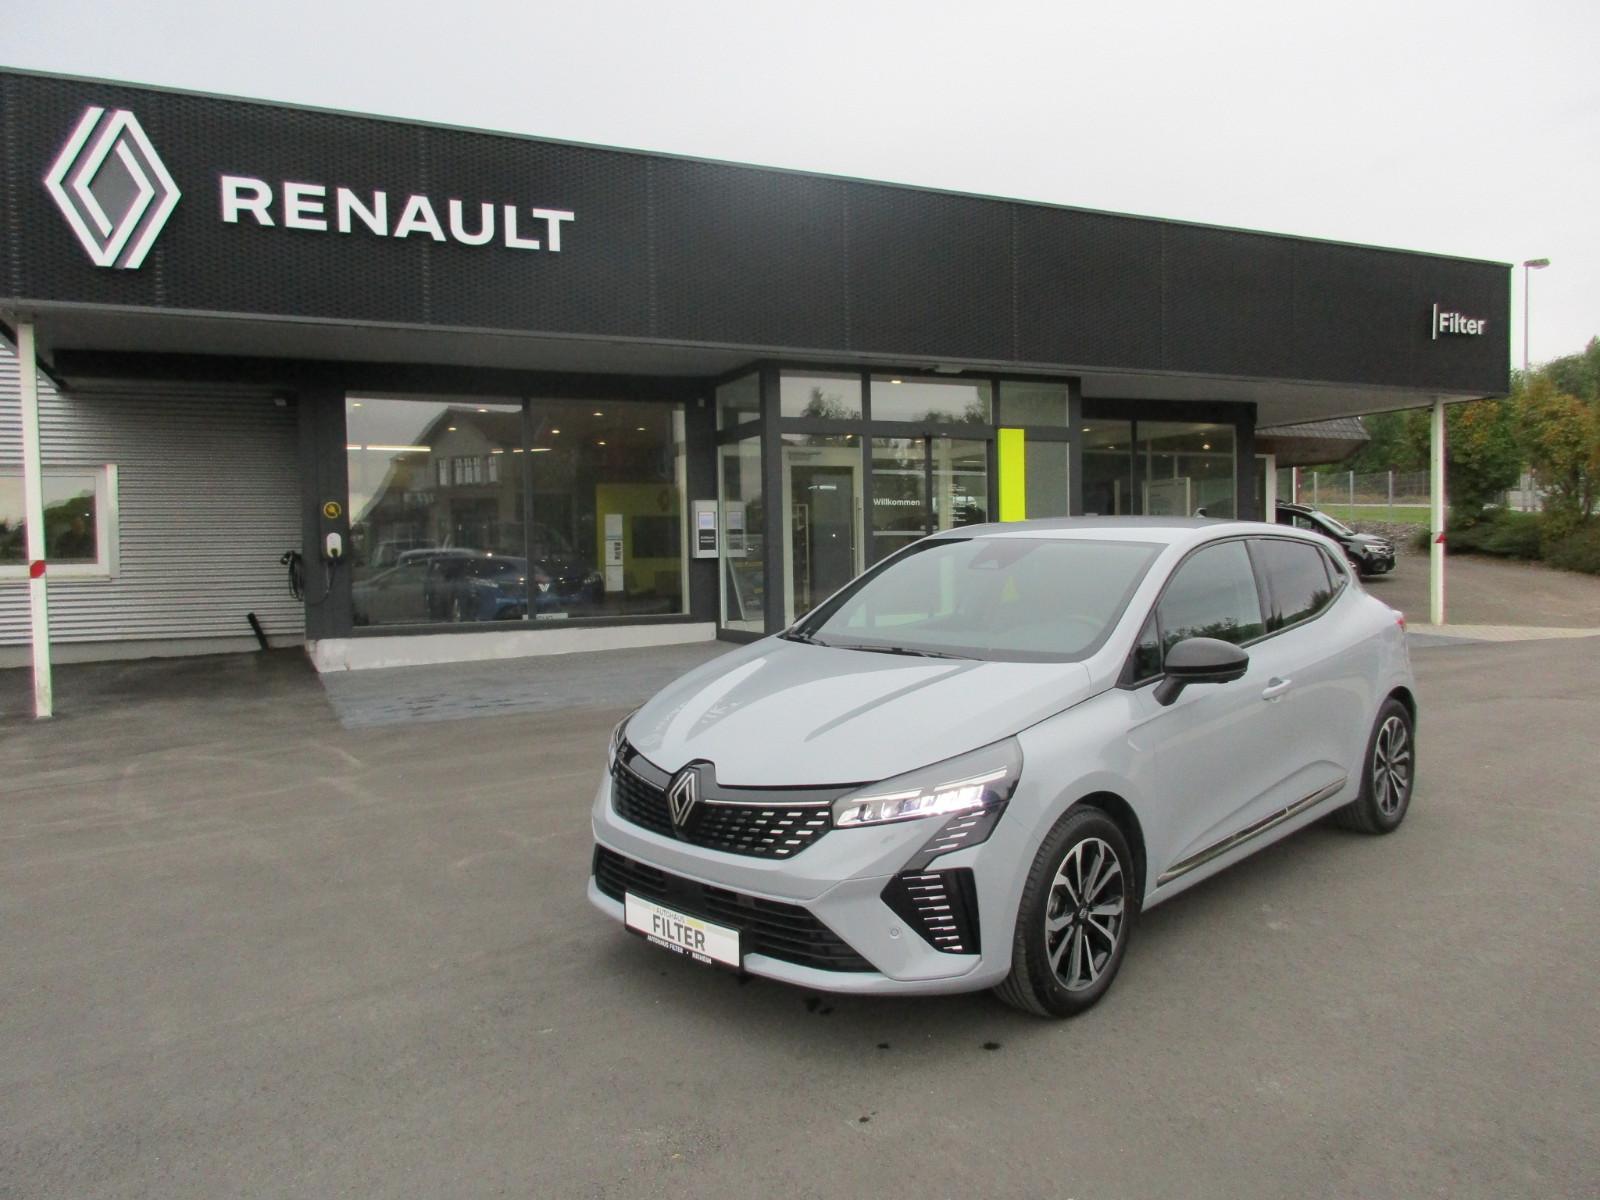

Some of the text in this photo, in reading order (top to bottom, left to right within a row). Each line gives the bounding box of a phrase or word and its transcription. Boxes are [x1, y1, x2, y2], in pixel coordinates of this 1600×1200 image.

[221, 175, 575, 252] RENAULT
[1439, 312, 1486, 335] Filter
[873, 497, 920, 507] Willkommen
[652, 914, 706, 952] FILTER
[669, 943, 683, 954] FILTER
